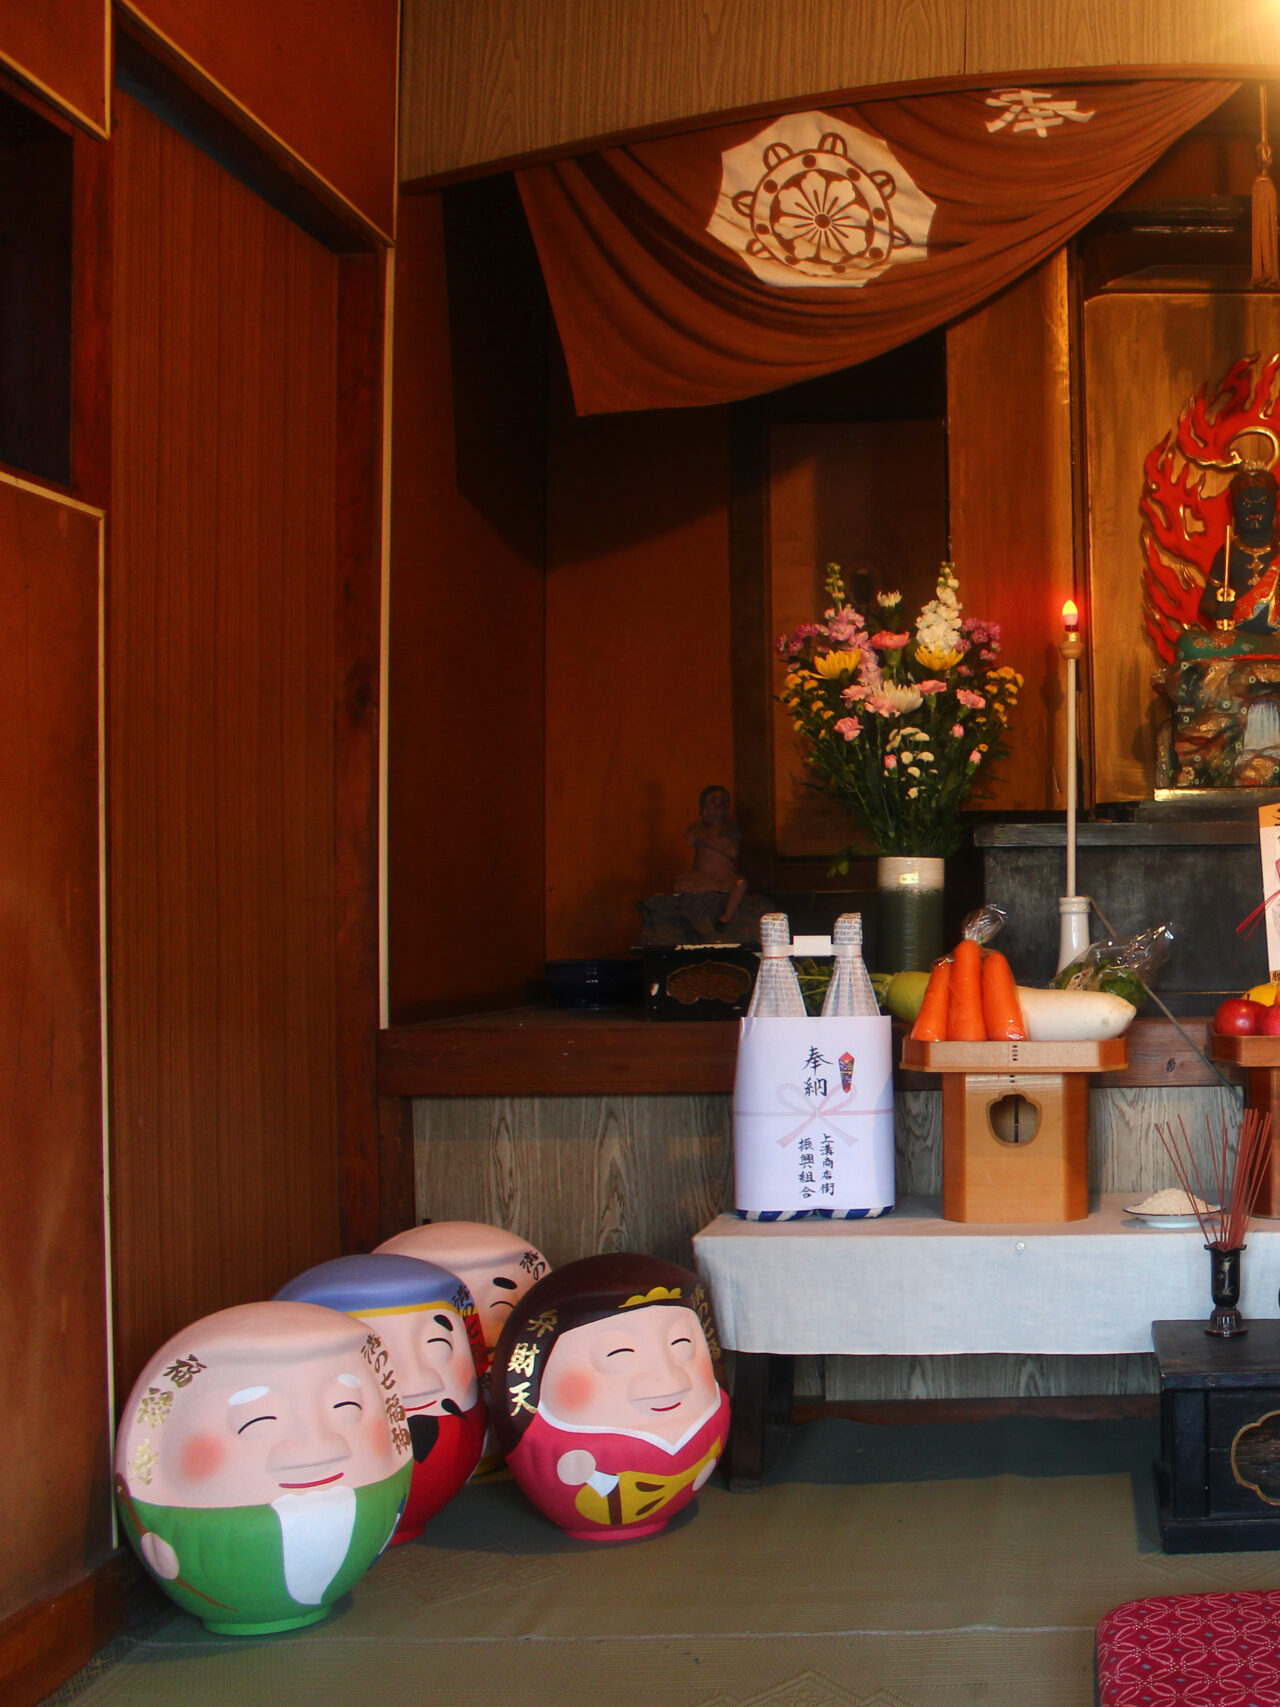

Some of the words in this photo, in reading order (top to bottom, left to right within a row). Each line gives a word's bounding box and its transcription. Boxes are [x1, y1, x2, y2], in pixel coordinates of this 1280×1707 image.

[985, 88, 1097, 138] 奉
[801, 1045, 834, 1097] 奉納
[798, 1137, 817, 1199] 振興組合
[819, 1132, 835, 1196] 上溝商店街
[507, 1308, 558, 1417] 弁財天
